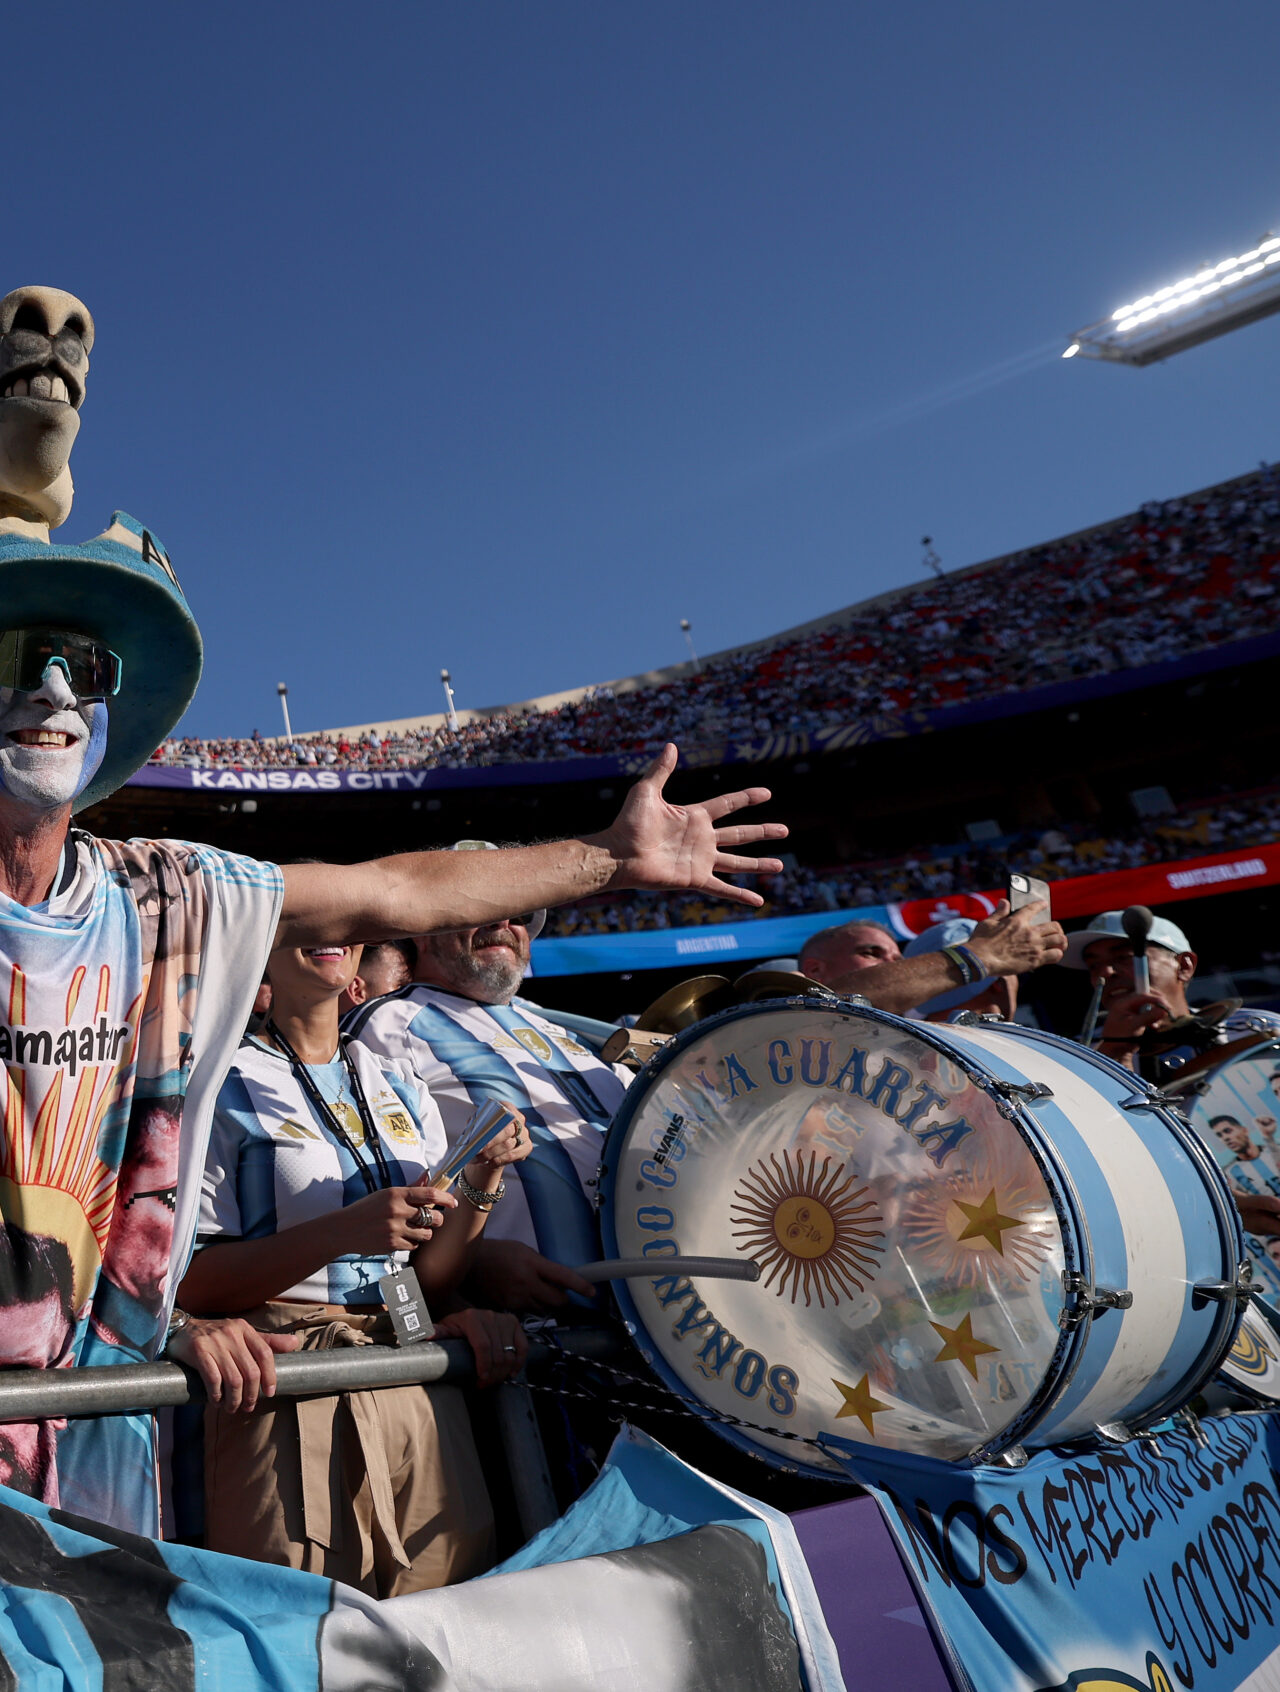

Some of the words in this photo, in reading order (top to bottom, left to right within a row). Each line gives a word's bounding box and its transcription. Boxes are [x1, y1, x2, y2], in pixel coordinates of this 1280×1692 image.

[191, 770, 341, 789] KANSAS
[347, 771, 427, 789] CITY
[653, 1113, 684, 1165] EVANS
[767, 1037, 975, 1168] CUARTA
[880, 1481, 1027, 1589] NOS
[1143, 1571, 1194, 1690] Y
